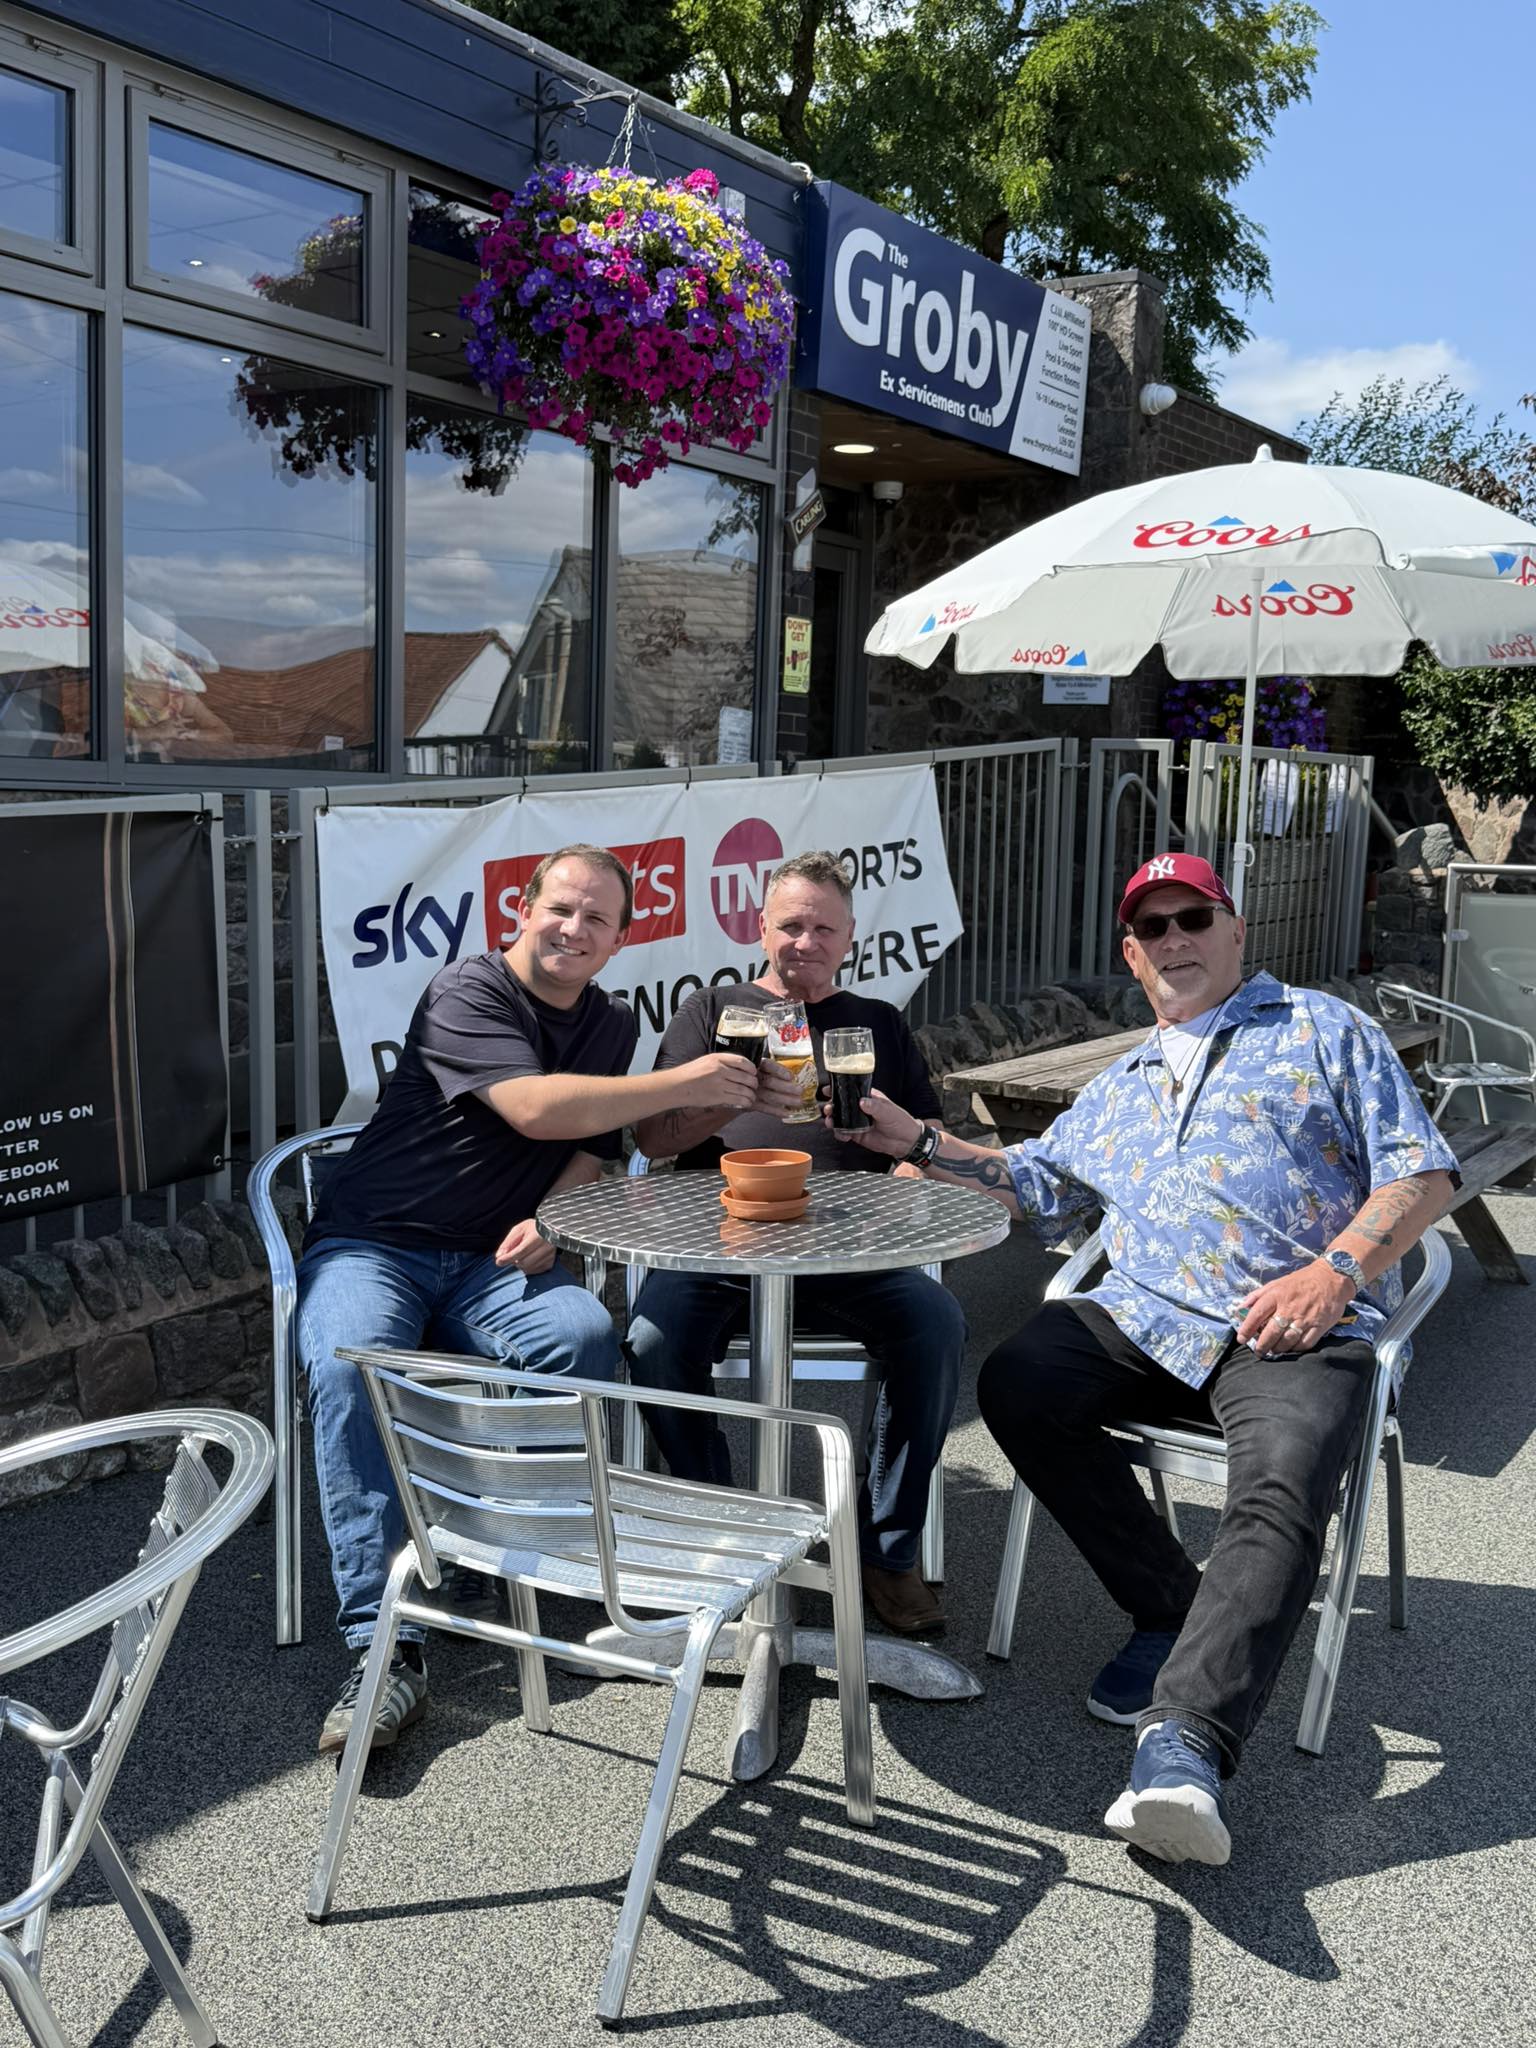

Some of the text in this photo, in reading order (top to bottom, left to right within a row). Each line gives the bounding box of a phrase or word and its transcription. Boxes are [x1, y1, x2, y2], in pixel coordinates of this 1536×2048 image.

[888, 243, 908, 269] The
[834, 227, 1029, 428] Groby
[1068, 328, 1084, 343] Screen
[1045, 349, 1057, 363] Pool
[1061, 357, 1081, 374] Snooker
[1058, 339, 1083, 359] Live Sport
[1041, 364, 1080, 390] Function Rooms
[880, 370, 992, 428] Ex Servicemens Club
[1067, 403, 1079, 416] Road
[1064, 414, 1077, 428] Groby
[795, 500, 822, 534] CARLING
[1133, 520, 1312, 548] Coors
[791, 631, 805, 642] GET
[839, 838, 922, 891] ORTS
[711, 857, 776, 916] TN
[352, 882, 473, 968] sky
[40, 1110, 63, 1126] US
[69, 1104, 94, 1120] ON
